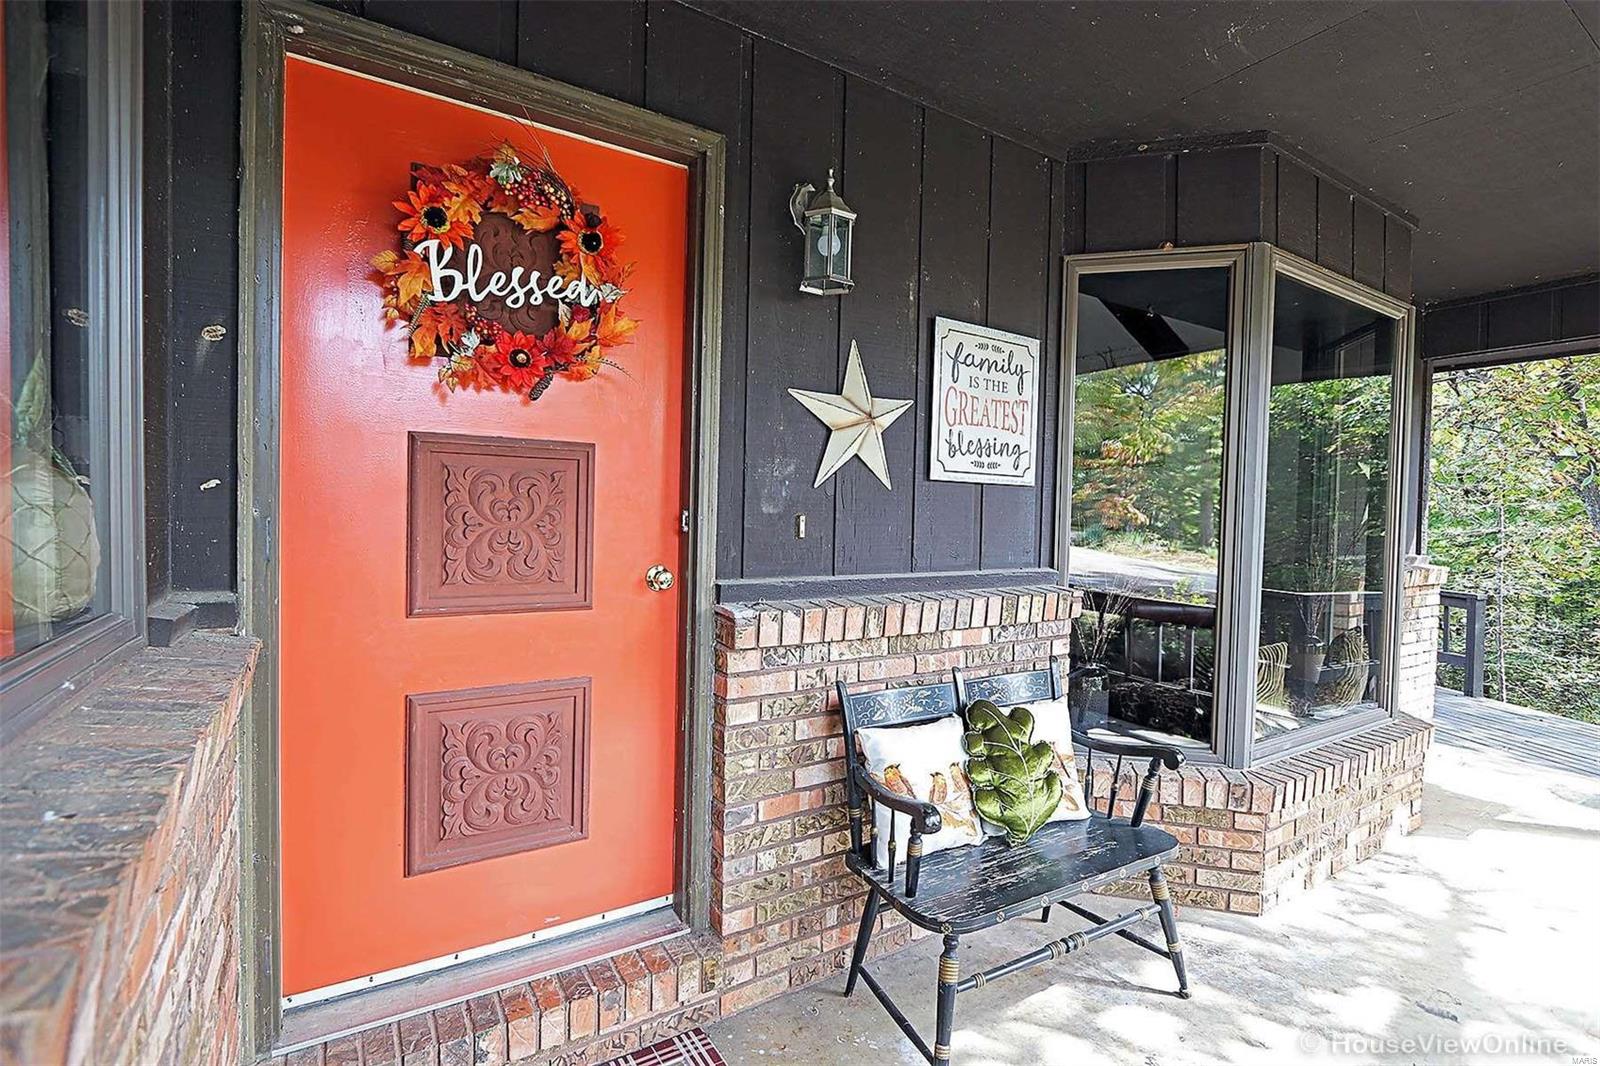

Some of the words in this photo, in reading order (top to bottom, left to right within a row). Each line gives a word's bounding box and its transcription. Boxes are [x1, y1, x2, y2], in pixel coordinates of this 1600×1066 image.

[414, 239, 603, 309] Blessed
[946, 341, 1031, 396] family
[969, 375, 980, 390] IS
[983, 377, 1009, 394] THE
[944, 385, 1029, 436] GREATEST
[945, 429, 1029, 471] blessing
